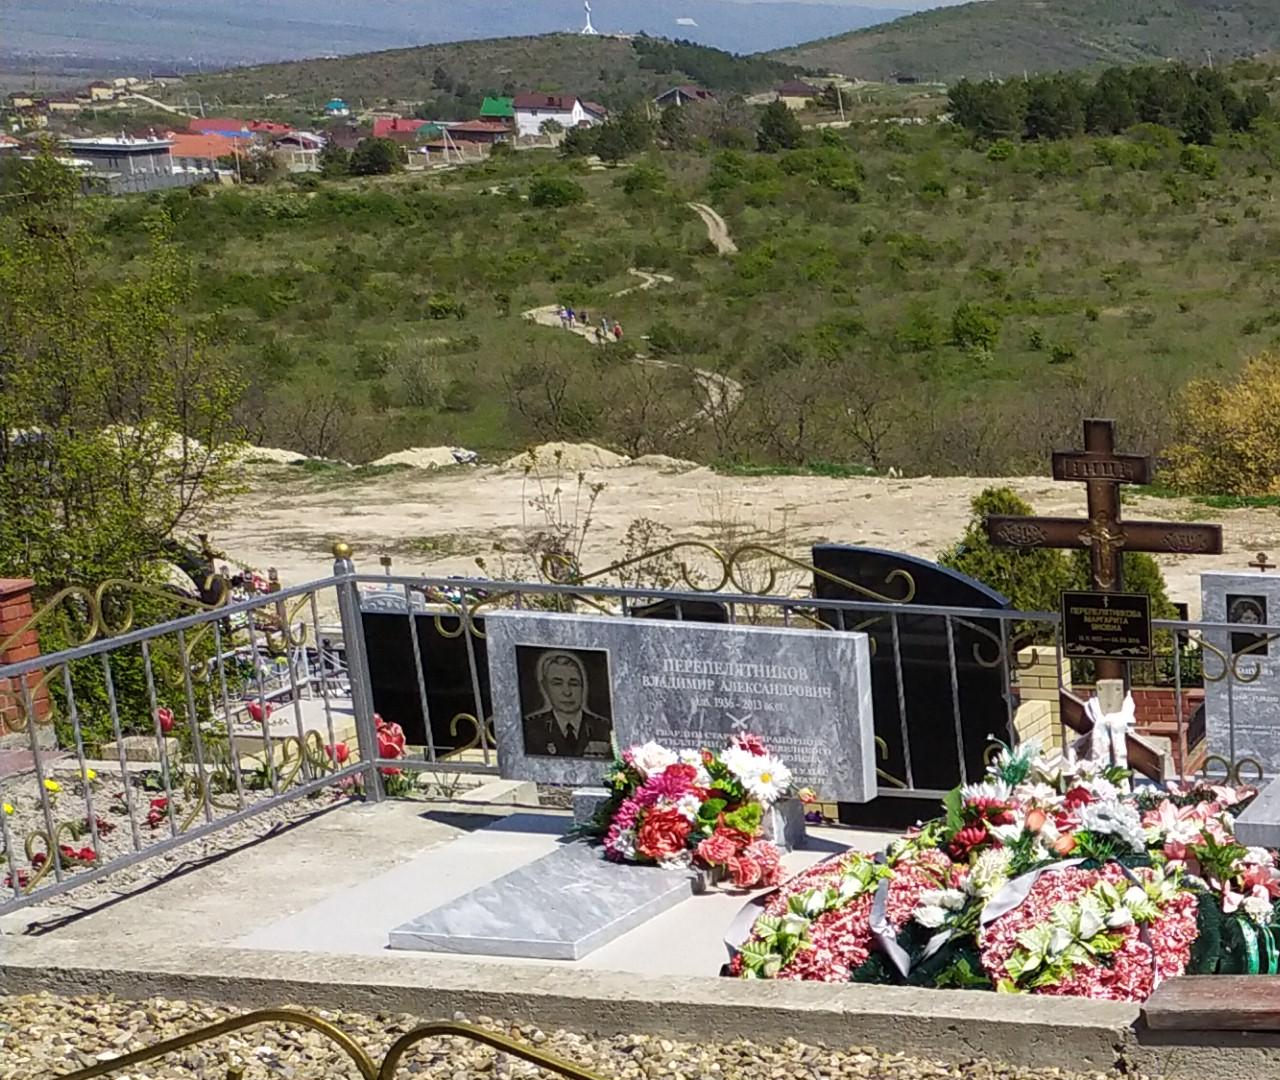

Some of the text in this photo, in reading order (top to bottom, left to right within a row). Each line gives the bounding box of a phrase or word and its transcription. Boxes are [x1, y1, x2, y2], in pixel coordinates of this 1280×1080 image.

[663, 658, 809, 681] ПЕРЕПЕЛЯТНИКОВ
[642, 676, 832, 698] ВЛАДИМИР АЛЕКСАНДРОВИЧ
